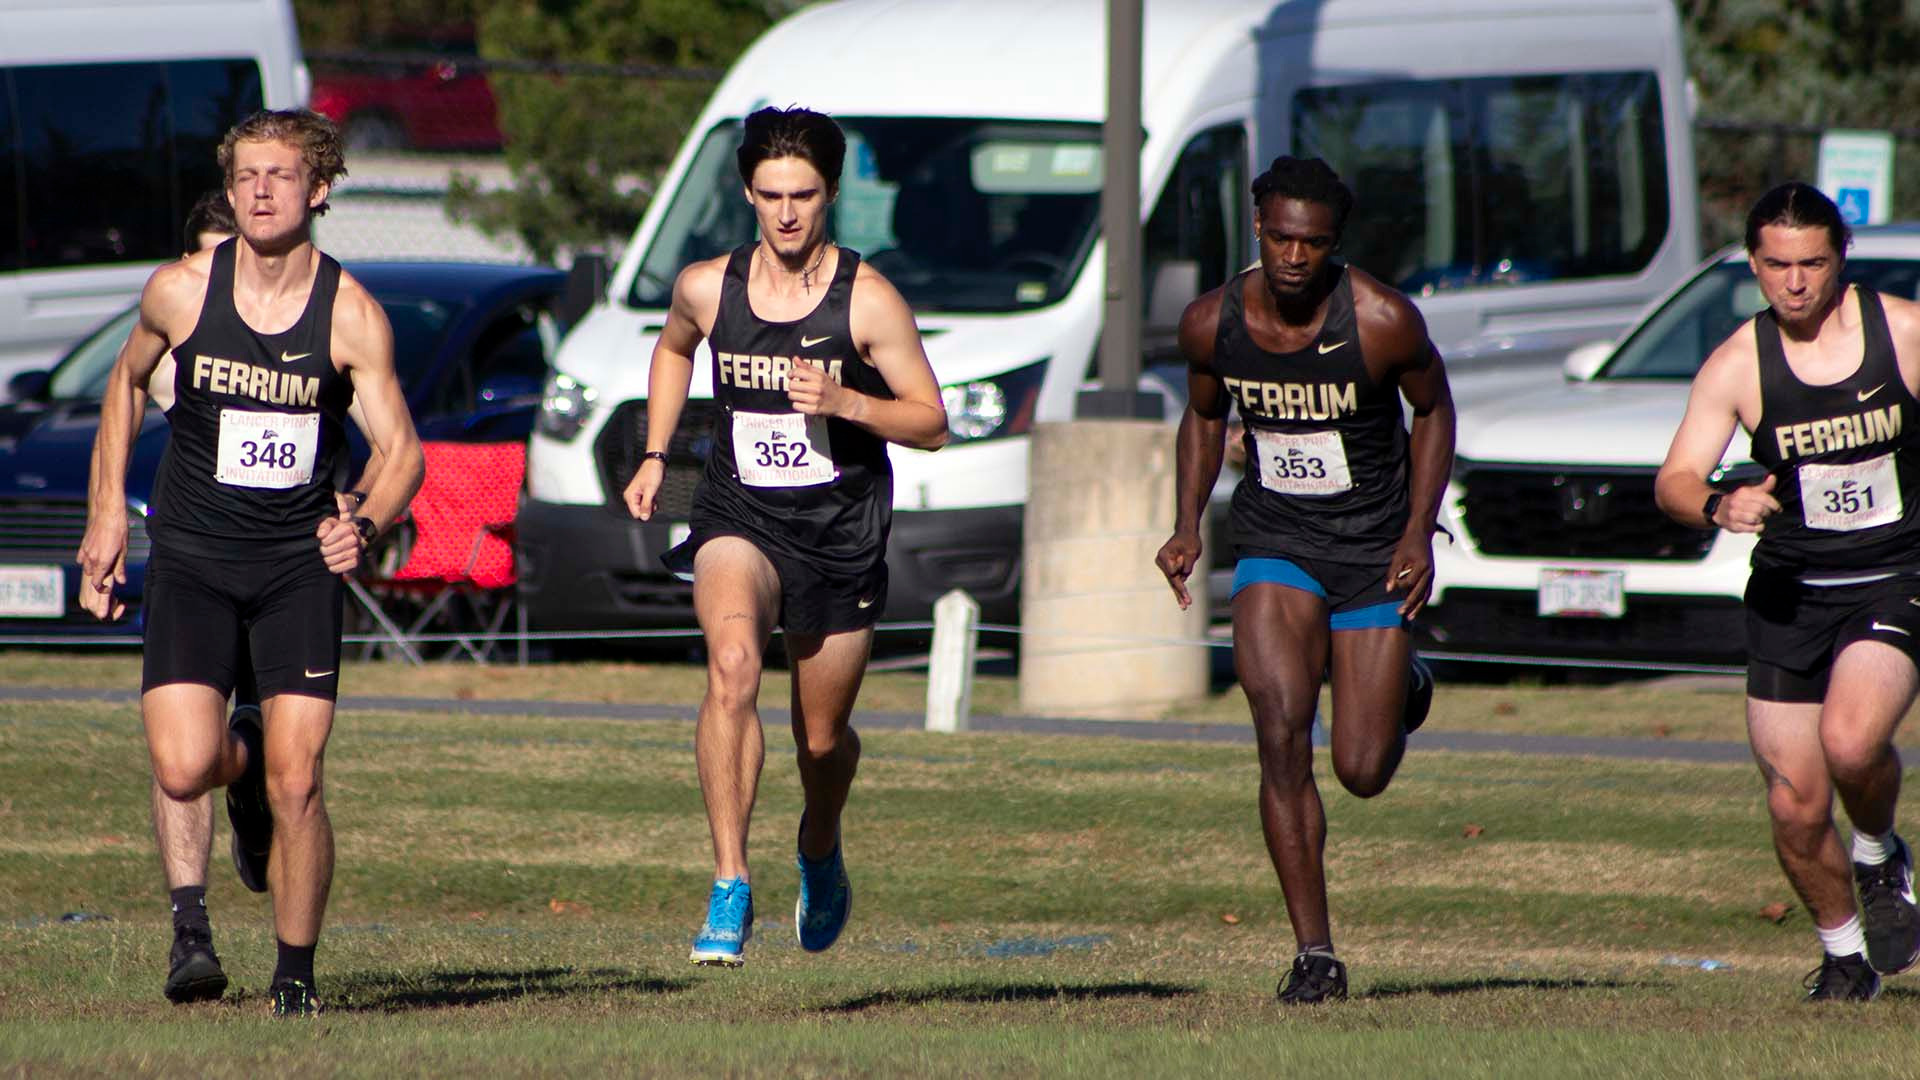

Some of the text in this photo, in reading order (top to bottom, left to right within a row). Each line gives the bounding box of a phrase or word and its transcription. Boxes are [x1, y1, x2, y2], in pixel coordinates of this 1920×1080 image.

[193, 355, 320, 407] FERRUM
[718, 352, 842, 392] FERRM
[230, 413, 311, 428] LANCER PINK
[1775, 404, 1902, 460] FERRUM
[240, 441, 297, 469] 348
[754, 442, 810, 468] 352
[1273, 456, 1327, 479] 353
[225, 466, 305, 482] INVITATIONAL
[1823, 486, 1875, 514] 351
